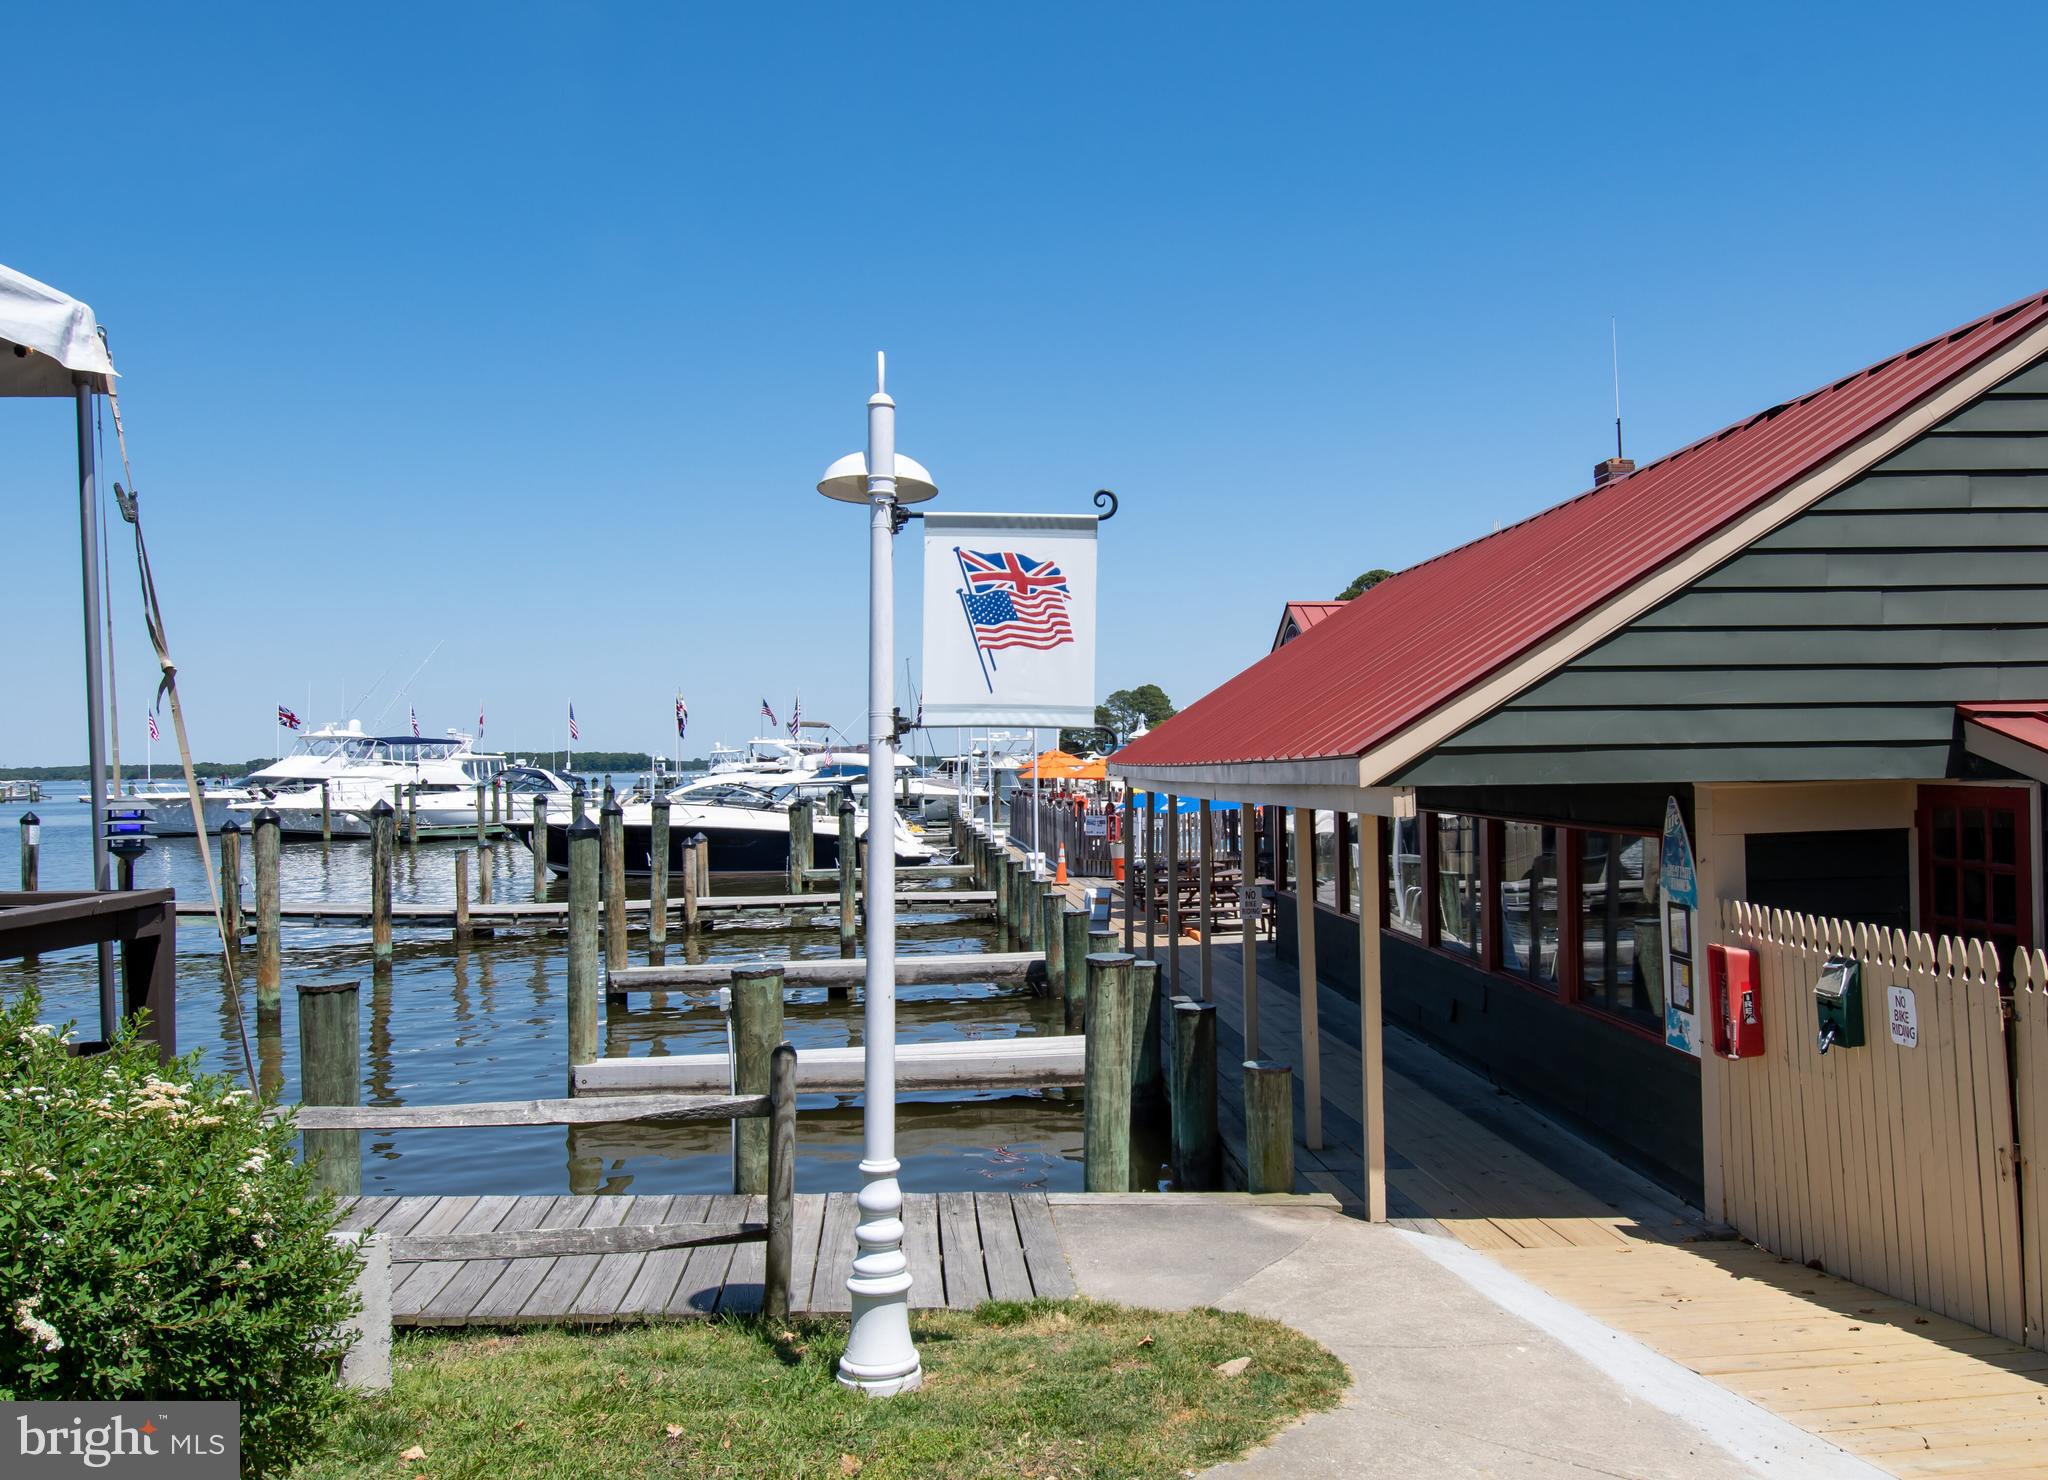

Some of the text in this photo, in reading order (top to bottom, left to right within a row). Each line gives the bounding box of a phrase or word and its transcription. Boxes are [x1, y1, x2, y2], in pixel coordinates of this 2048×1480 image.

[1245, 891, 1256, 899] NO
[1895, 995, 1906, 1008] NO
[1894, 1009, 1909, 1024] BIKE
[1892, 1022, 1915, 1039] RIDING
